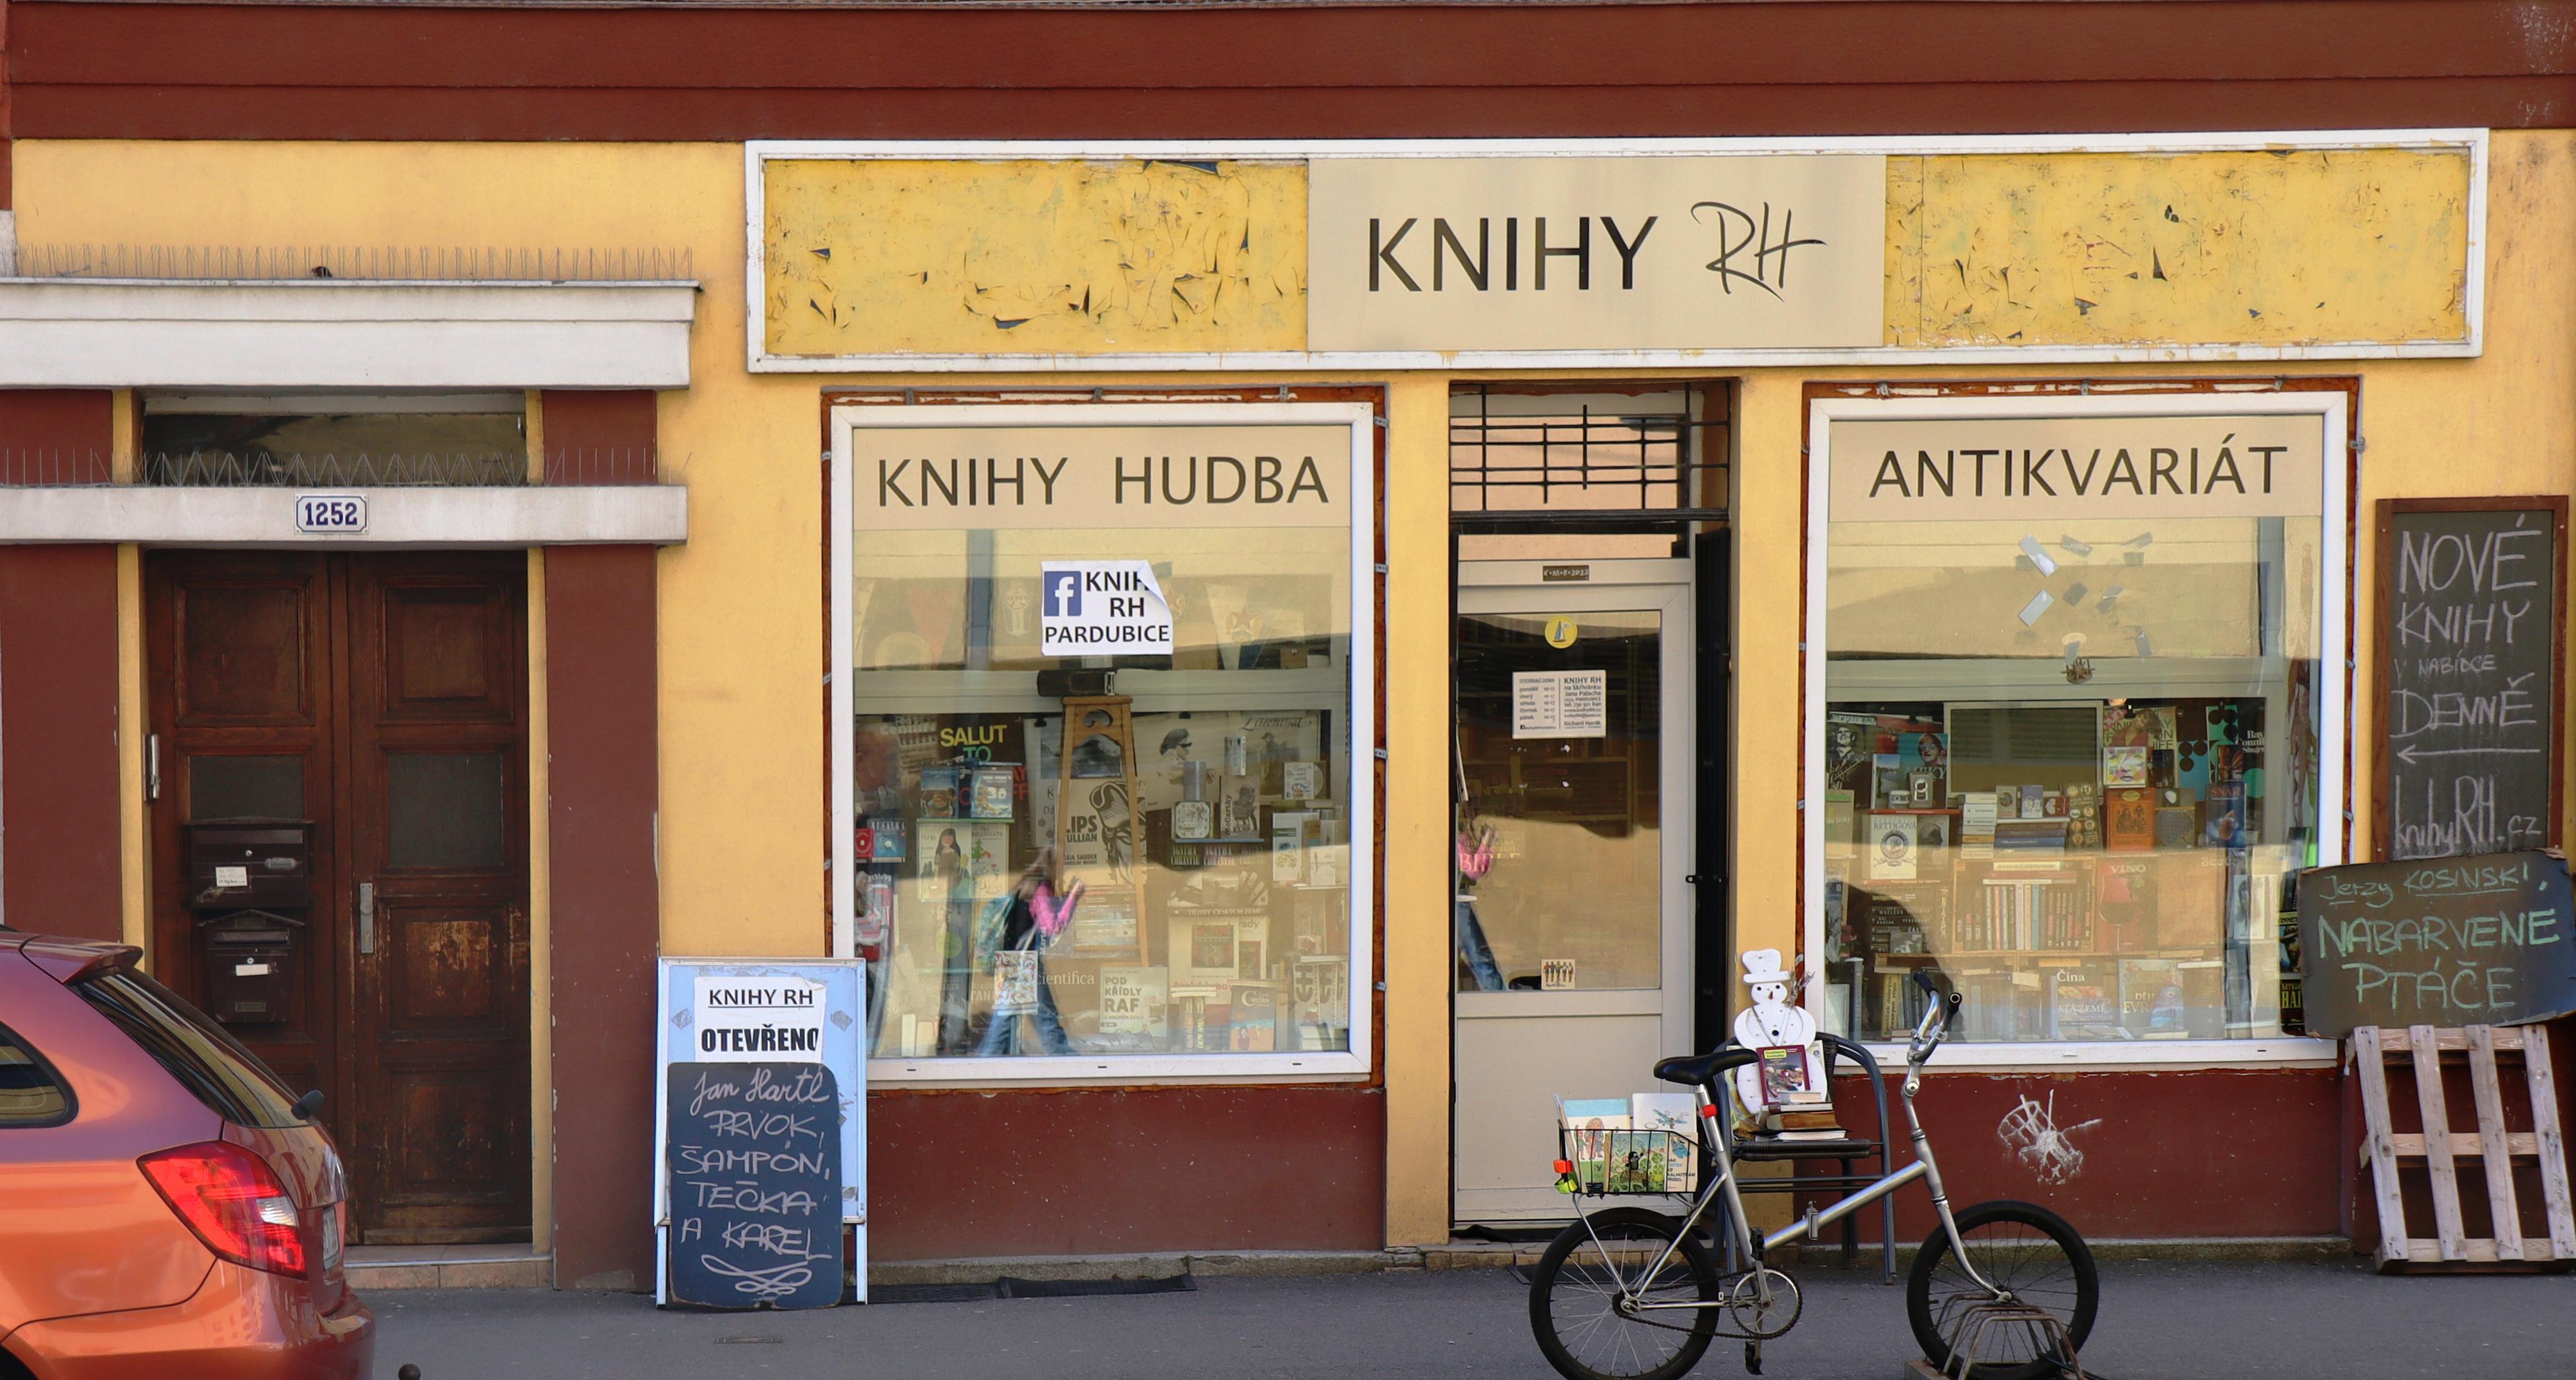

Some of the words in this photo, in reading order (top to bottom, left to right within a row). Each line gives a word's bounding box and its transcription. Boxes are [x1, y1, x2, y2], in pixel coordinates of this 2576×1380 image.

[1368, 216, 1658, 292] KNIHY
[1690, 200, 1828, 303] RH
[1869, 433, 2287, 498] ANTIKVARIÁT
[878, 457, 1068, 507] KNIHY
[1114, 455, 1329, 504] HUDBA
[305, 502, 358, 527] 1252
[2399, 514, 2542, 594] NOVÉ
[1086, 571, 1150, 592] KNIH
[1110, 597, 1144, 618] RH
[1045, 625, 1170, 643] PARDUBICE
[2396, 601, 2530, 645] KNIHY
[2418, 649, 2497, 676] NABÍDCE
[2390, 672, 2536, 737] DENNĚ
[940, 724, 1008, 748] SALUT
[962, 745, 992, 762] TO
[1066, 815, 1097, 833] IPS
[1066, 833, 1097, 843] ULLIAN
[2319, 874, 2394, 907] Jerzy
[1239, 919, 1260, 929] rady
[1037, 971, 1095, 985] cientifica
[1104, 976, 1127, 985] POD
[2056, 968, 2085, 982] Čína
[2342, 956, 2516, 1010] PTÁČE
[708, 989, 777, 1005] KNIHY
[784, 989, 813, 1005] RH
[1104, 986, 1142, 996] KŘÍDLY
[1104, 998, 1140, 1013] RAF
[701, 1024, 819, 1052] OTEVŘENO
[690, 1072, 739, 1116] Jan
[746, 1068, 830, 1103] Hartl
[703, 1110, 825, 1149] PRVOK,
[676, 1140, 831, 1181] ŠAMPÓN,
[686, 1180, 818, 1216] TEČKA
[681, 1218, 703, 1243] A
[721, 1221, 833, 1260] KAREL
